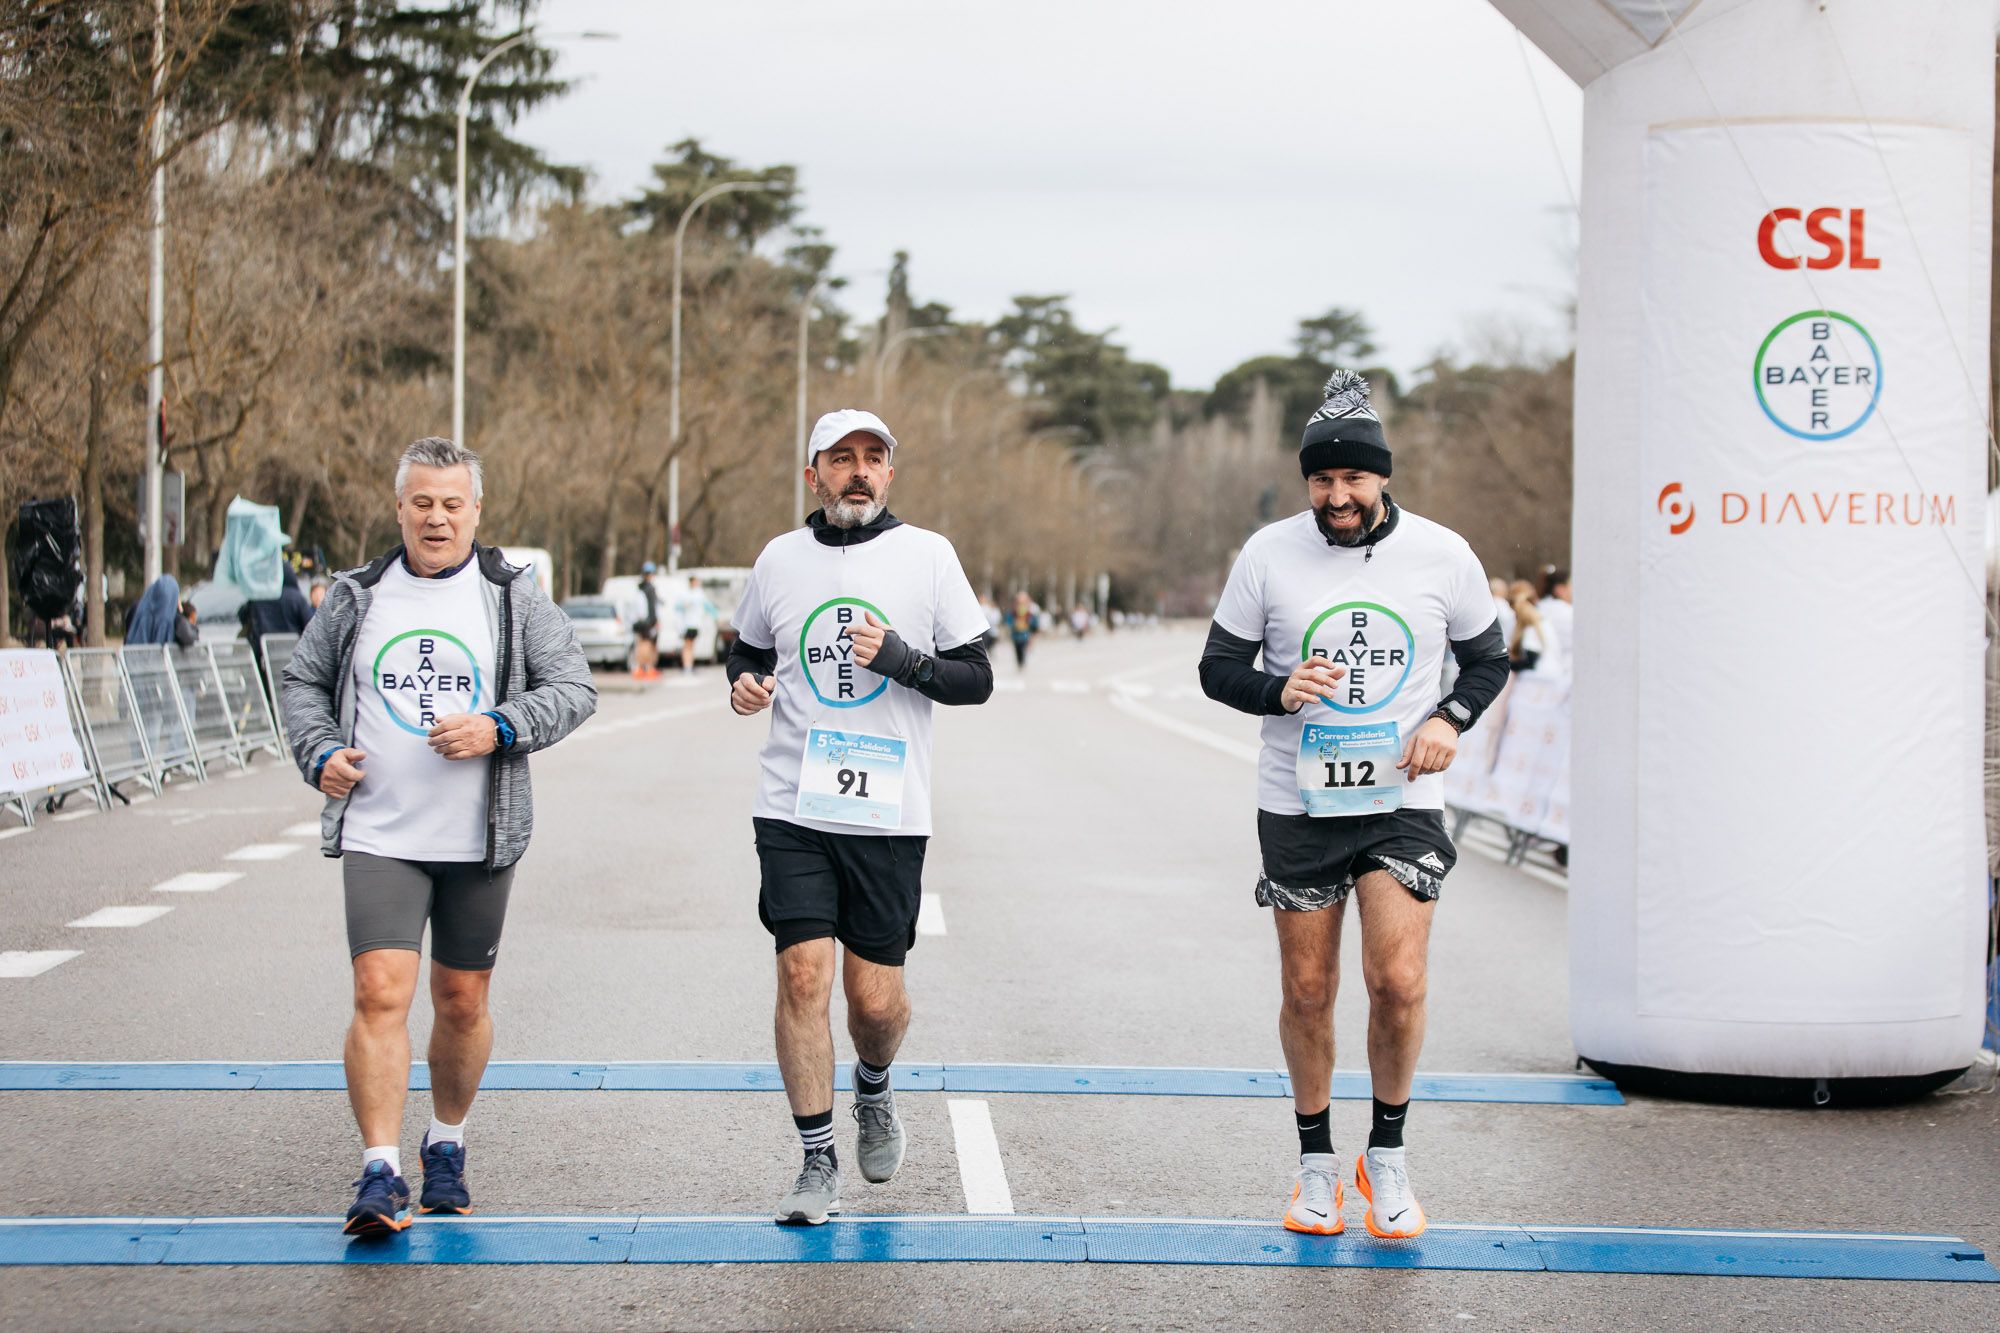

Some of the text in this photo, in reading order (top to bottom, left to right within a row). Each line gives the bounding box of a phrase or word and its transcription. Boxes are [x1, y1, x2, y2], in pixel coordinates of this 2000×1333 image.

[1757, 207, 1881, 270] CSL
[1766, 366, 1872, 386] BAYER
[1809, 322, 1832, 430] BAYER
[1721, 492, 1956, 526] DIAVERUM
[807, 644, 854, 664] BAY
[836, 607, 856, 699] BAYER
[1348, 611, 1369, 705] BAYER
[382, 673, 472, 692] BAYER
[417, 638, 436, 727] BAYER
[829, 737, 859, 748] Carrera
[859, 740, 891, 753] Solidaria
[1319, 732, 1350, 741] Carrera
[1351, 730, 1386, 740] Solidaria
[837, 768, 869, 799] 91
[1324, 760, 1376, 788] 112
